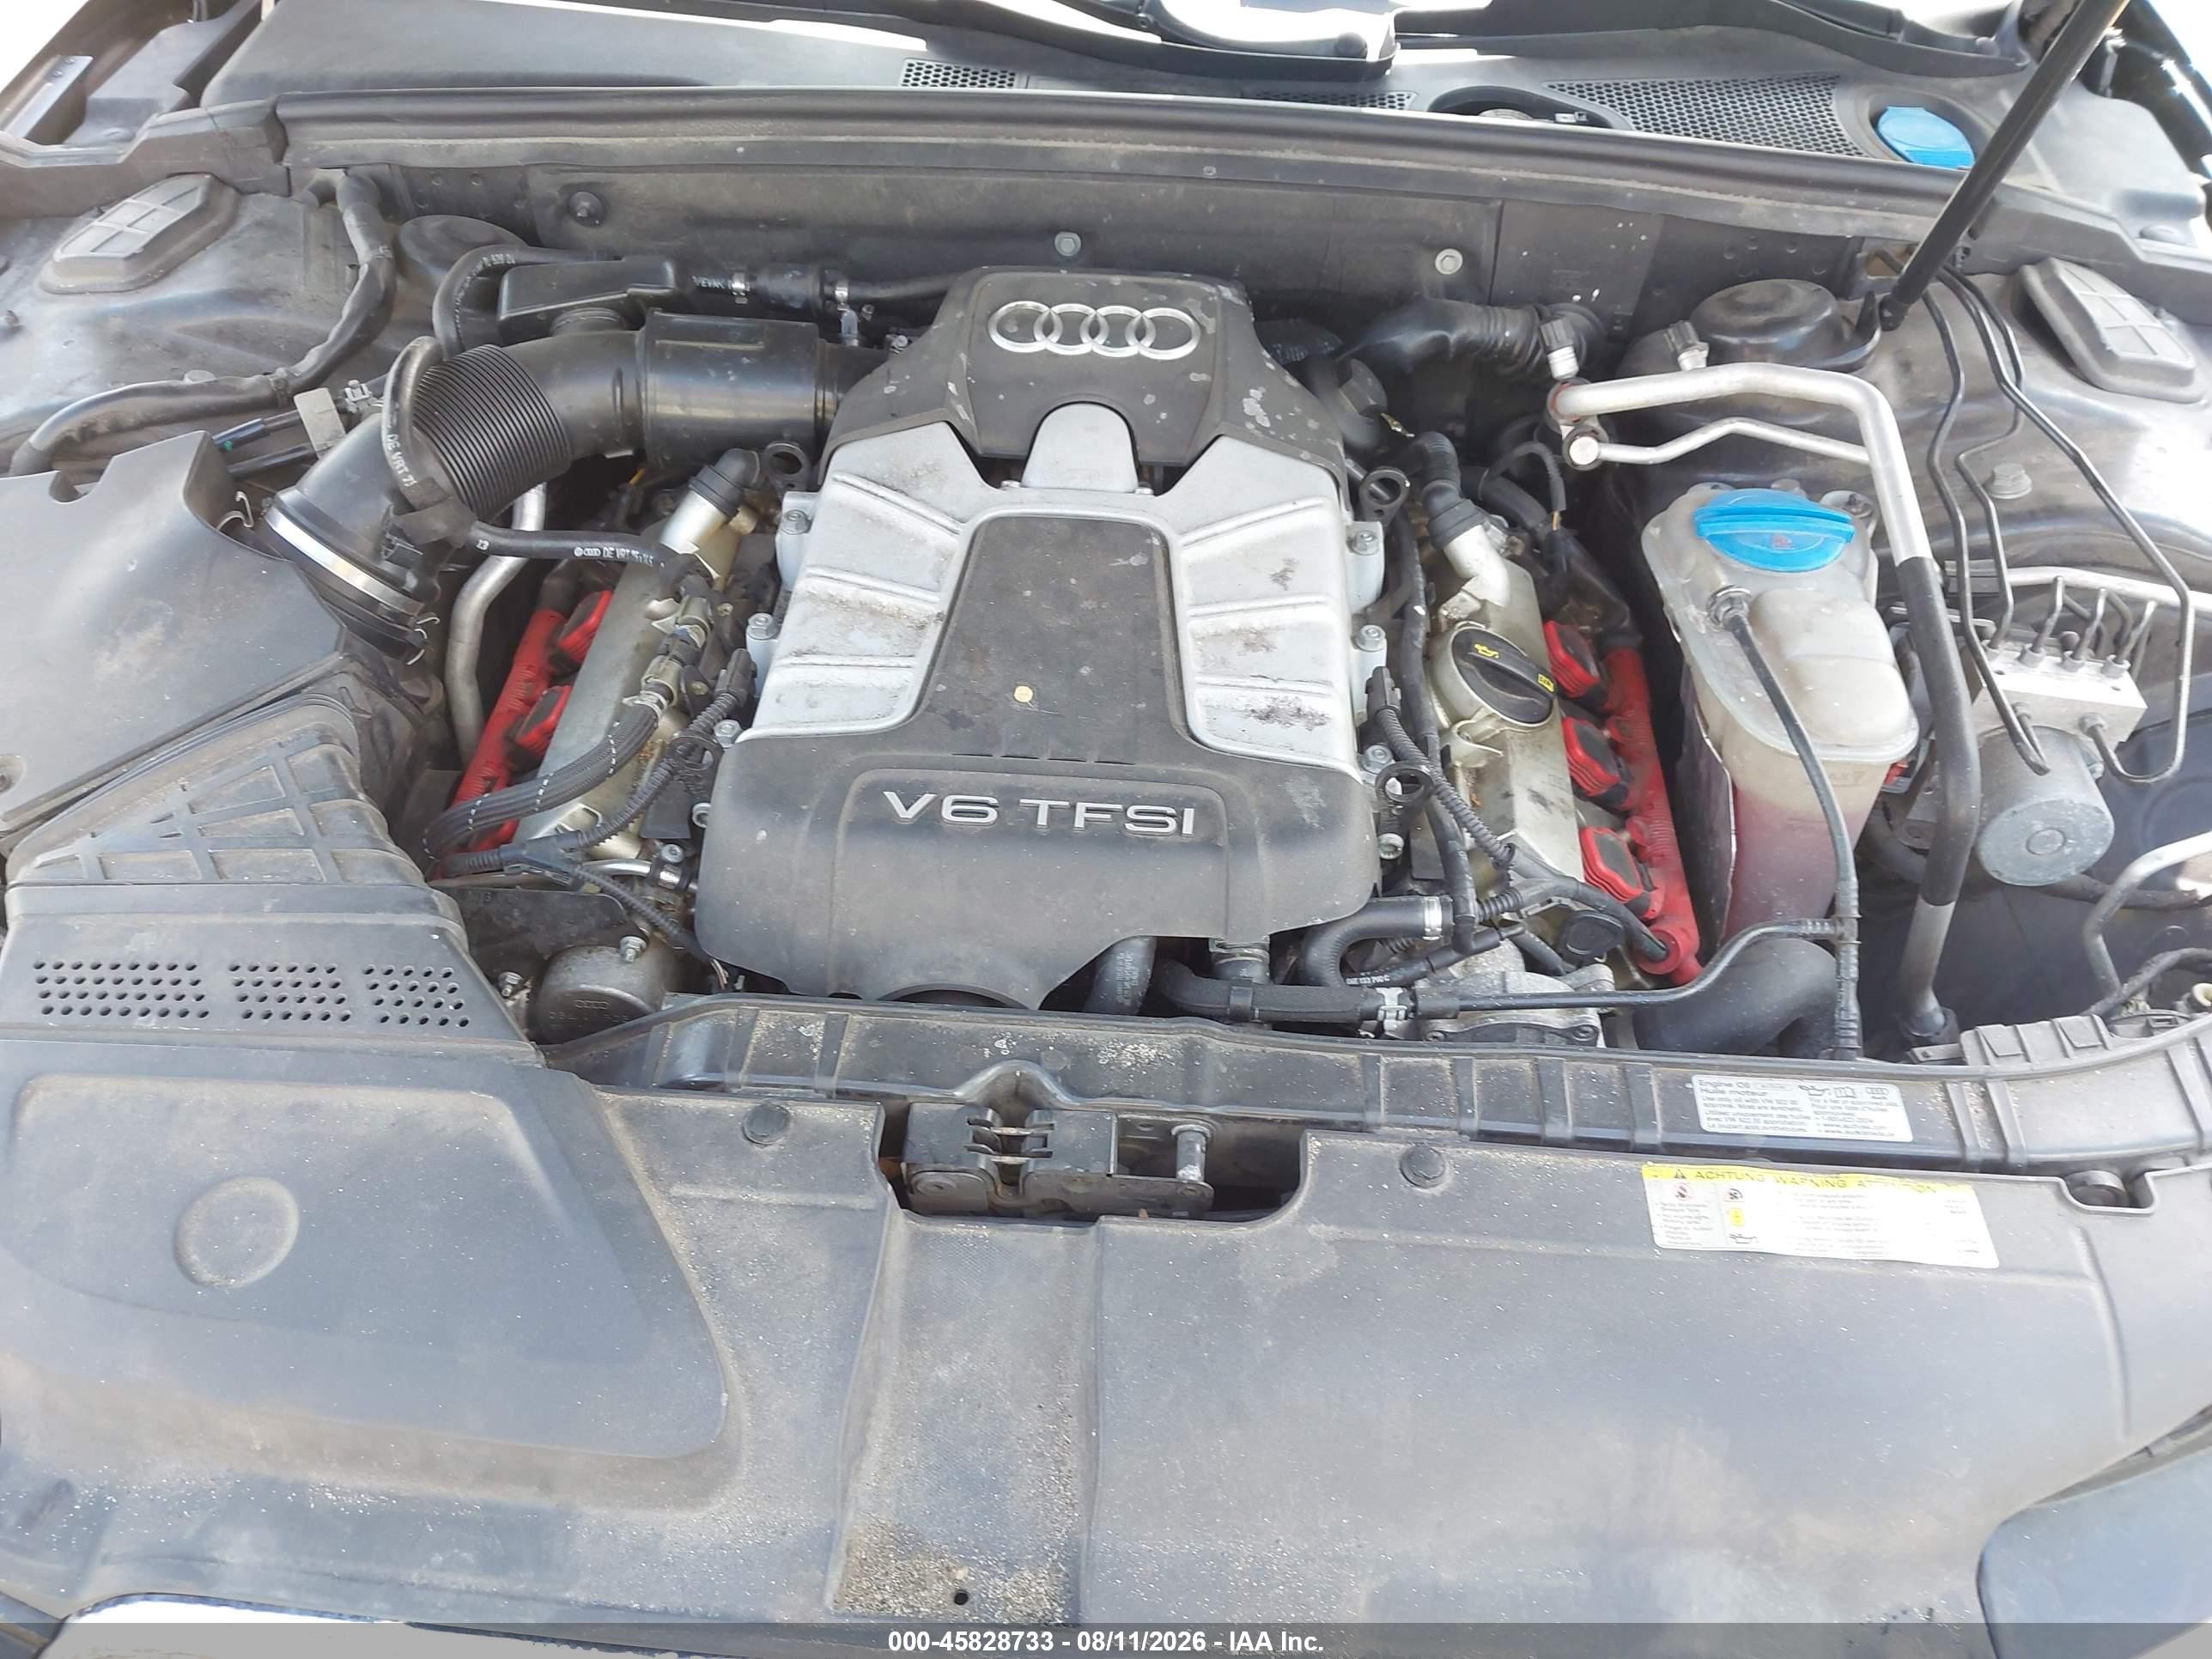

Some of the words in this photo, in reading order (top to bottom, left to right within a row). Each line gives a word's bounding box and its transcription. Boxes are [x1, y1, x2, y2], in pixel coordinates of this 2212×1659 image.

[883, 791, 1000, 824] V6
[1019, 799, 1196, 836] TFSI
[1698, 1079, 1733, 1089] Engine
[1736, 1080, 1751, 1089] Oil
[1700, 1086, 1726, 1095] Huile
[1695, 1170, 1765, 1182] ACHTUNG
[1772, 1175, 1848, 1188] WARNING
